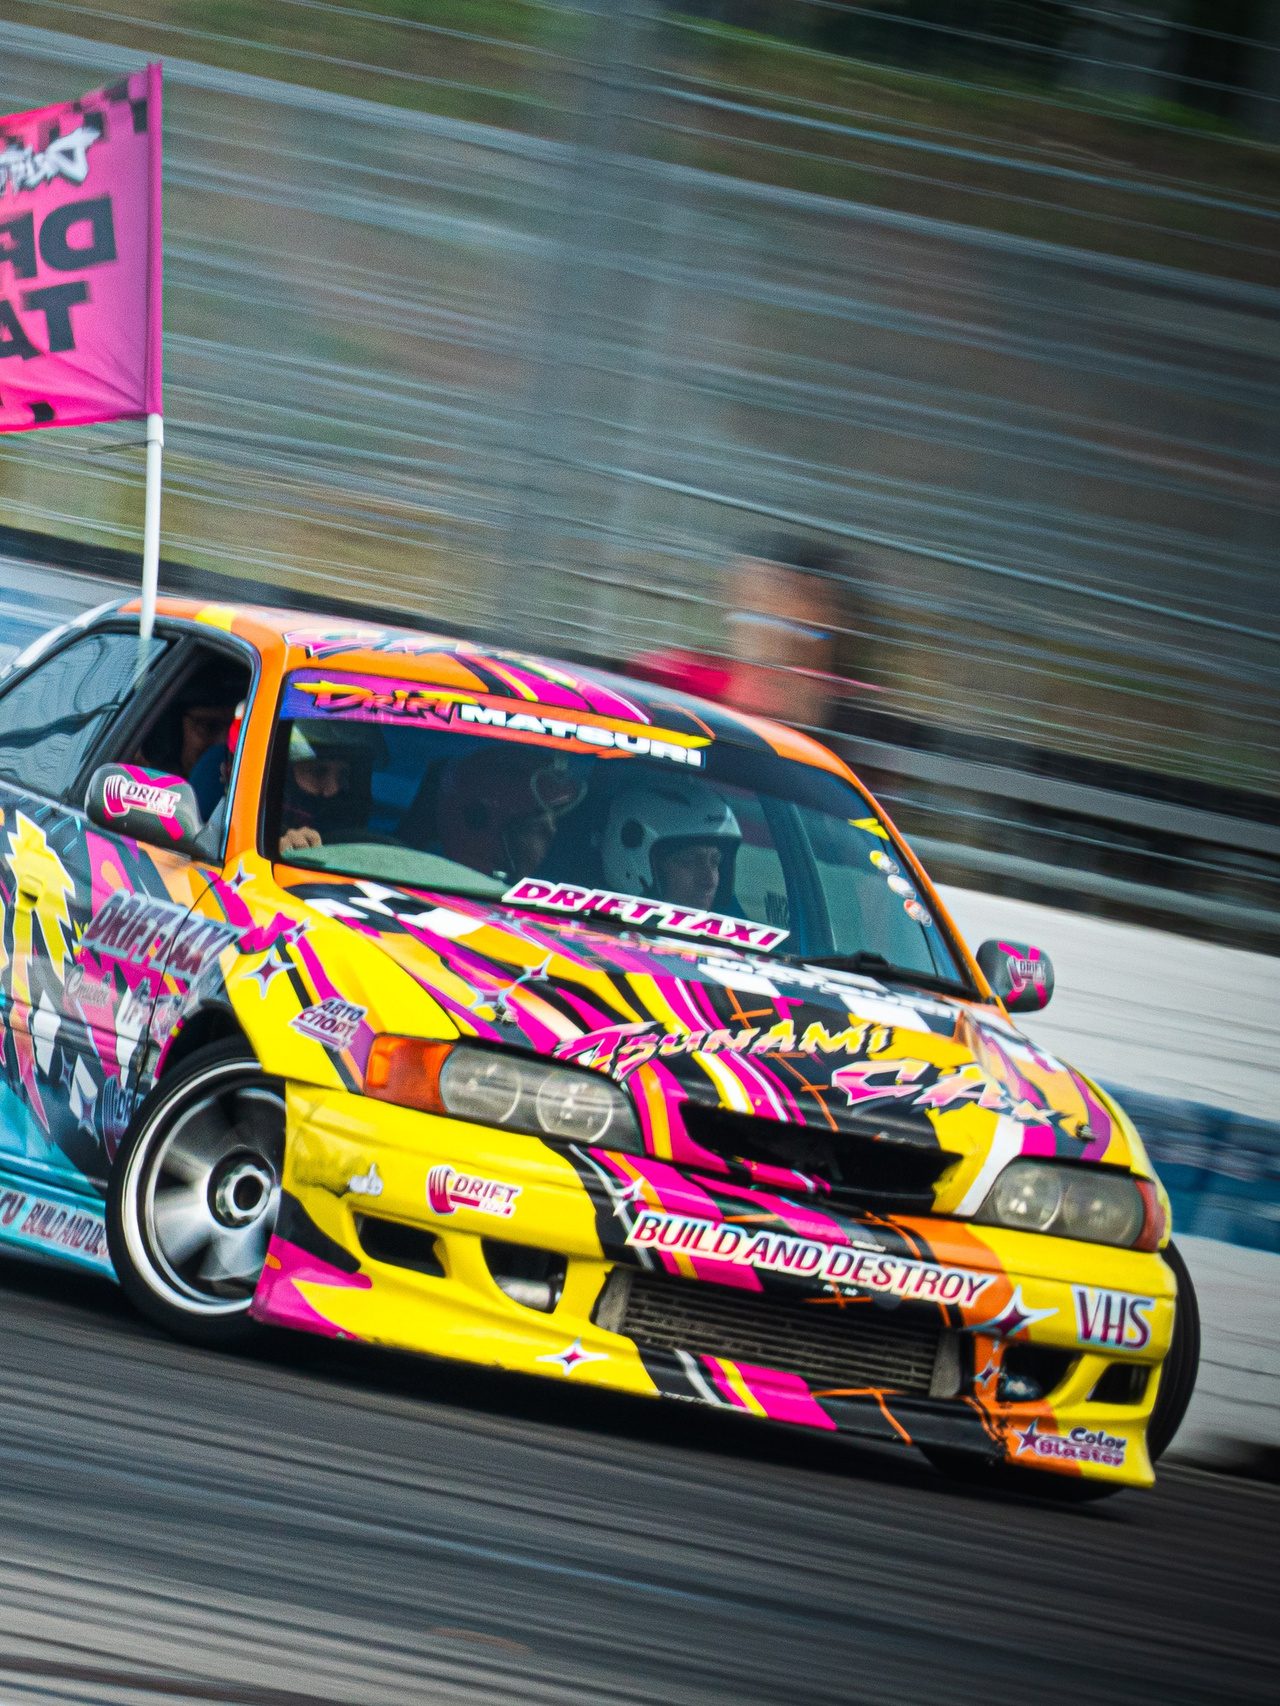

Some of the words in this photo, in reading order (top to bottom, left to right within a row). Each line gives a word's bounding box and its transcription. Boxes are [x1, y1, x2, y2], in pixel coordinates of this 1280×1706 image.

[461, 704, 702, 766] MATSURI
[126, 784, 180, 808] DRIFT
[552, 1020, 894, 1082] TSUNAMI
[453, 1176, 519, 1203] DRIFT
[634, 1216, 749, 1256] BUILD
[745, 1236, 822, 1272] AND
[827, 1251, 989, 1302] DESTROY
[1079, 1290, 1152, 1349] VHS
[1038, 1439, 1125, 1466] Blaster
[1070, 1427, 1126, 1449] Color
